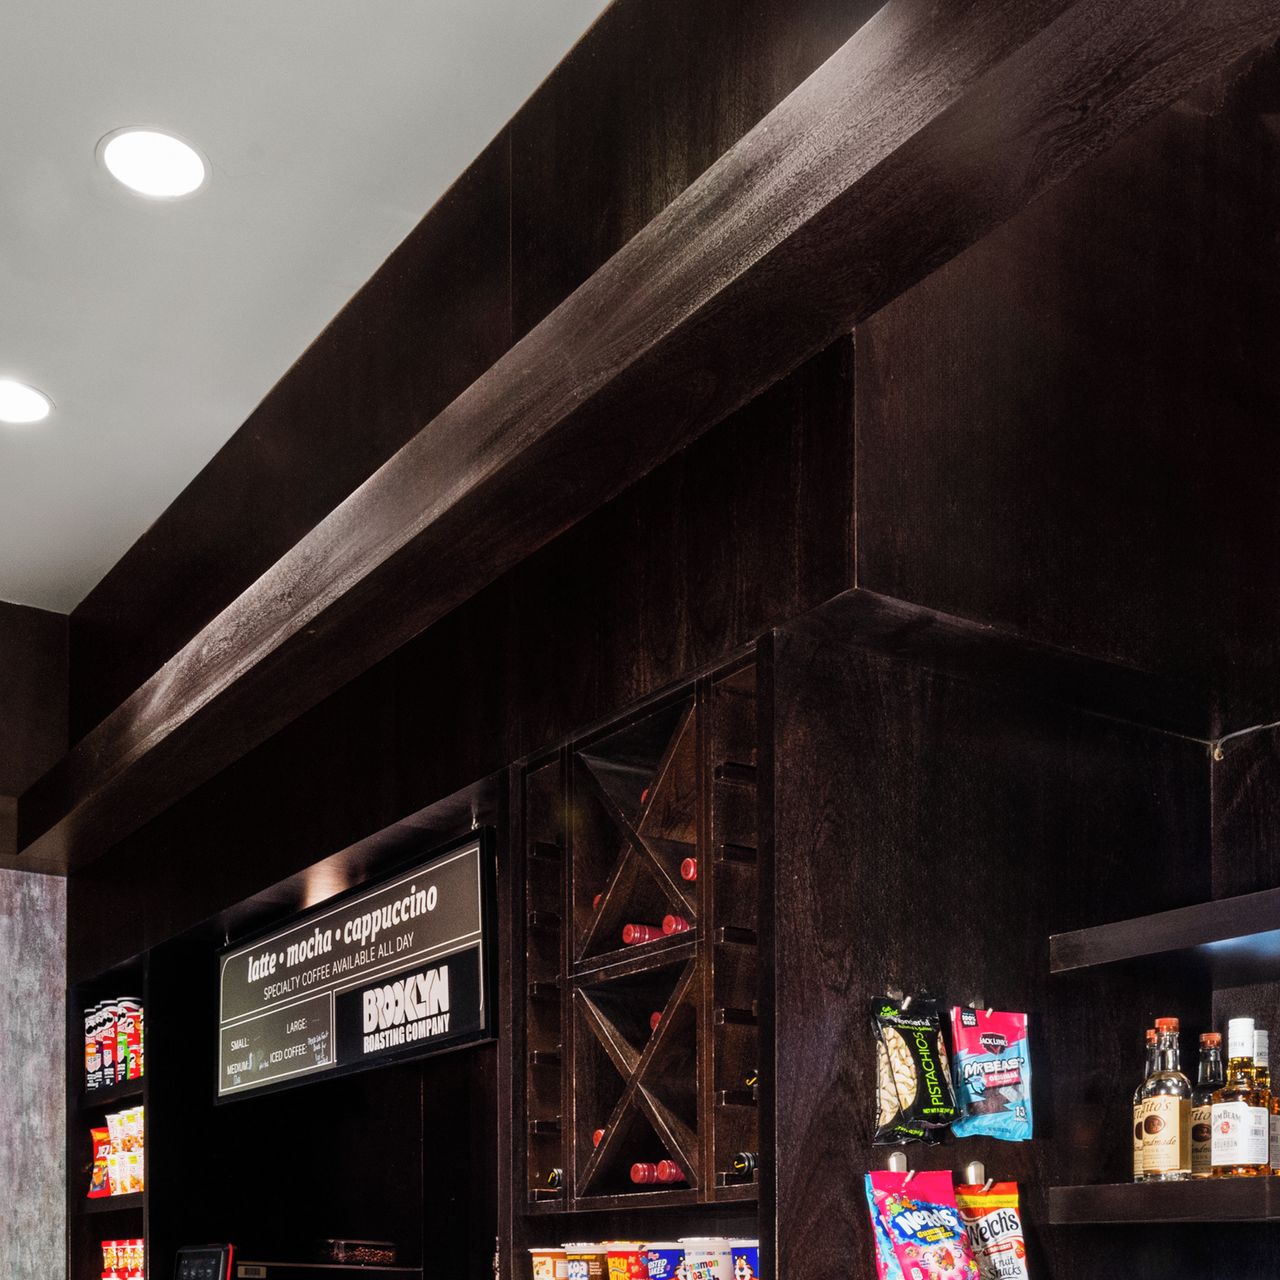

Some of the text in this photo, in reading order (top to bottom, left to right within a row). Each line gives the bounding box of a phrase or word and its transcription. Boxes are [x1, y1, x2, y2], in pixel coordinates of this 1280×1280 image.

[247, 885, 438, 983] latte mocha cappuccino
[263, 932, 414, 1001] SPECIALTY COFFEE AVAILABLE ALL DAY
[363, 964, 449, 1034] BROOKLYN
[363, 1025, 405, 1054] ROASTING
[406, 1012, 450, 1043] COMPANY
[912, 1032, 943, 1106] PISTACHIOS
[1015, 1106, 1025, 1117] 13
[1142, 1100, 1171, 1112] Tito's
[970, 1211, 1019, 1246] Welch's
